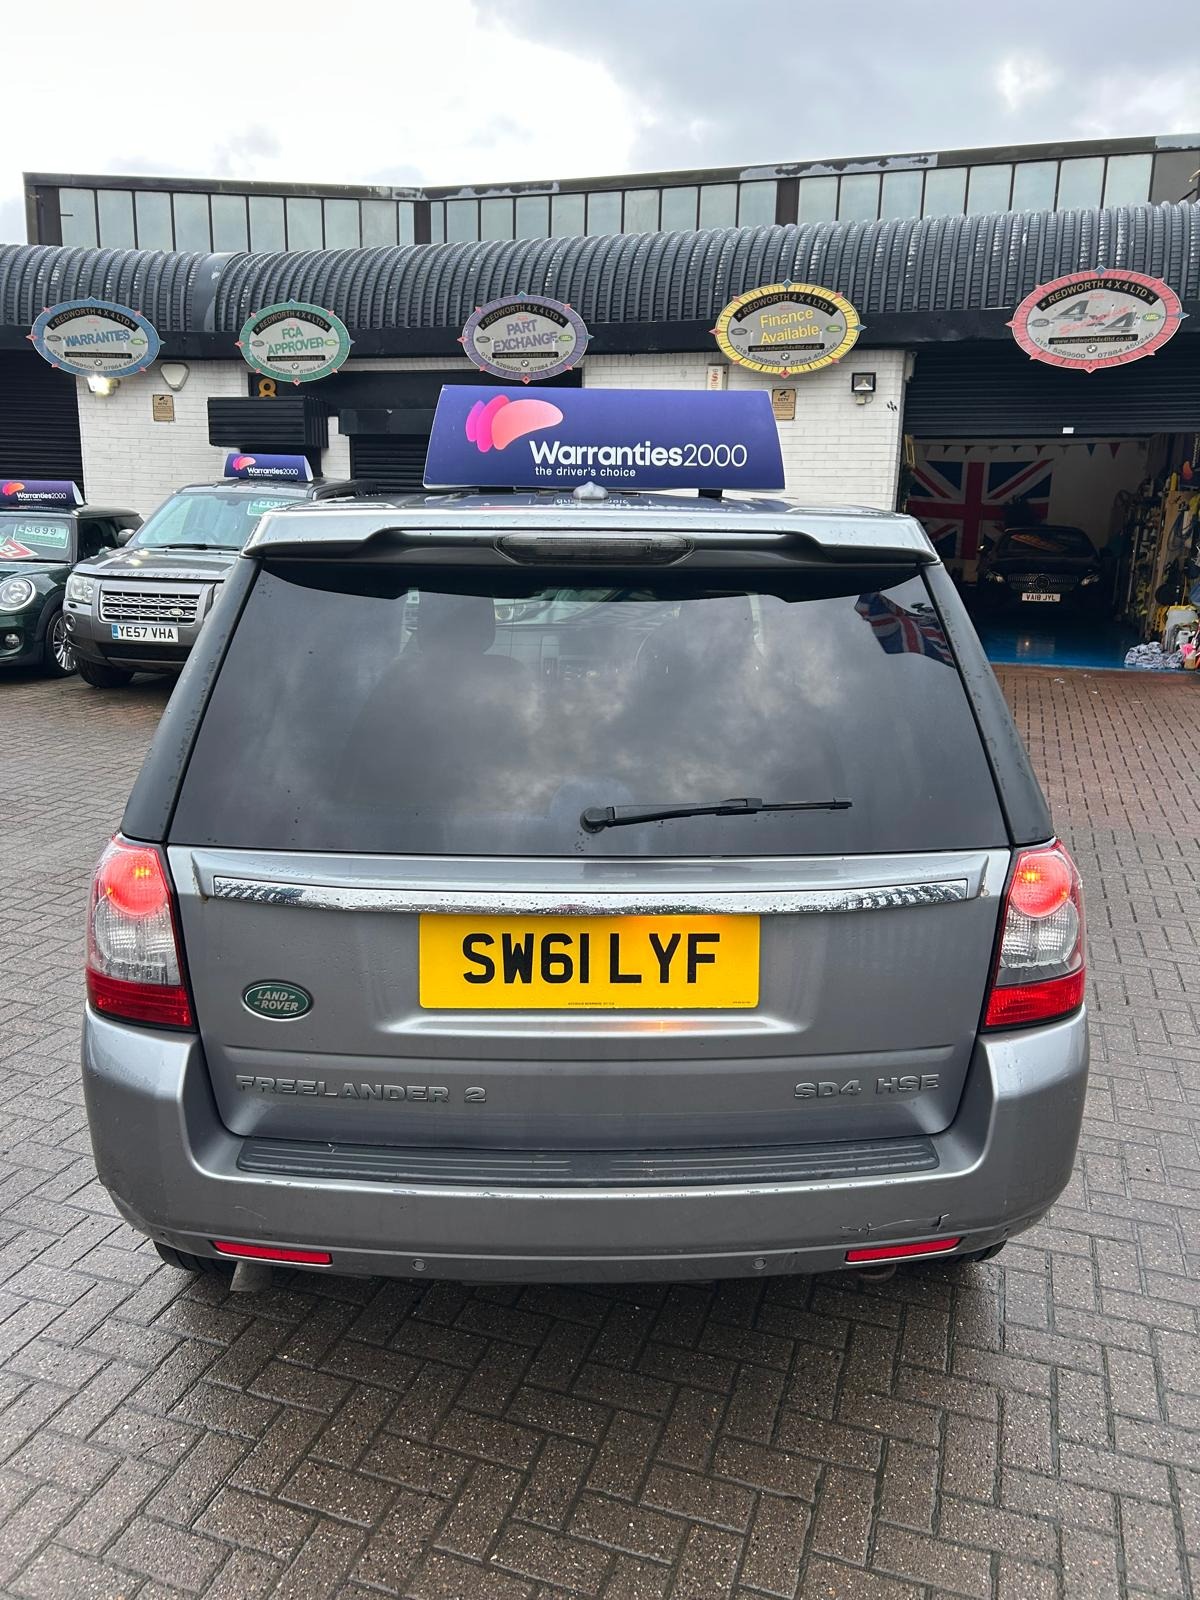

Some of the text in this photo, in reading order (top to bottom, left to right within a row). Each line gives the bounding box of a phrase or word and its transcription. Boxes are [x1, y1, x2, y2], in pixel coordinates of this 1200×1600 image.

[1048, 281, 1104, 303] REDWORTH
[1106, 280, 1112, 288] 4
[1114, 281, 1121, 289] X
[1123, 283, 1129, 291] 4
[1130, 284, 1148, 297] LTD
[742, 293, 790, 314] REDWORTH
[806, 296, 812, 304] 4
[812, 298, 828, 310] LTD
[54, 307, 96, 326] REDWORTH
[116, 314, 131, 326] LTD
[260, 310, 295, 329] REDWORTH
[312, 315, 325, 327] LTD
[485, 304, 559, 324] REDWORTH 4 X 4 LTD
[760, 308, 814, 328] Finance
[282, 326, 303, 339] FCA
[506, 319, 537, 336] PART
[760, 324, 820, 345] Available
[64, 329, 131, 347] WARRANTIES
[267, 336, 324, 355] APPROVED
[493, 331, 559, 352] EXCHANGE
[529, 440, 748, 468] Warranties2000
[247, 467, 299, 475] Warranties2000
[535, 466, 636, 477] the driver's choice
[16, 492, 67, 500] Warranties2000
[118, 625, 174, 639] YE57 VHA
[462, 933, 720, 984] SW61 LYF
[257, 990, 288, 1001] LAND
[261, 1000, 299, 1012] ROVER
[236, 1074, 487, 1104] FREELANDER 2
[794, 1073, 940, 1099] SD4 HSE
